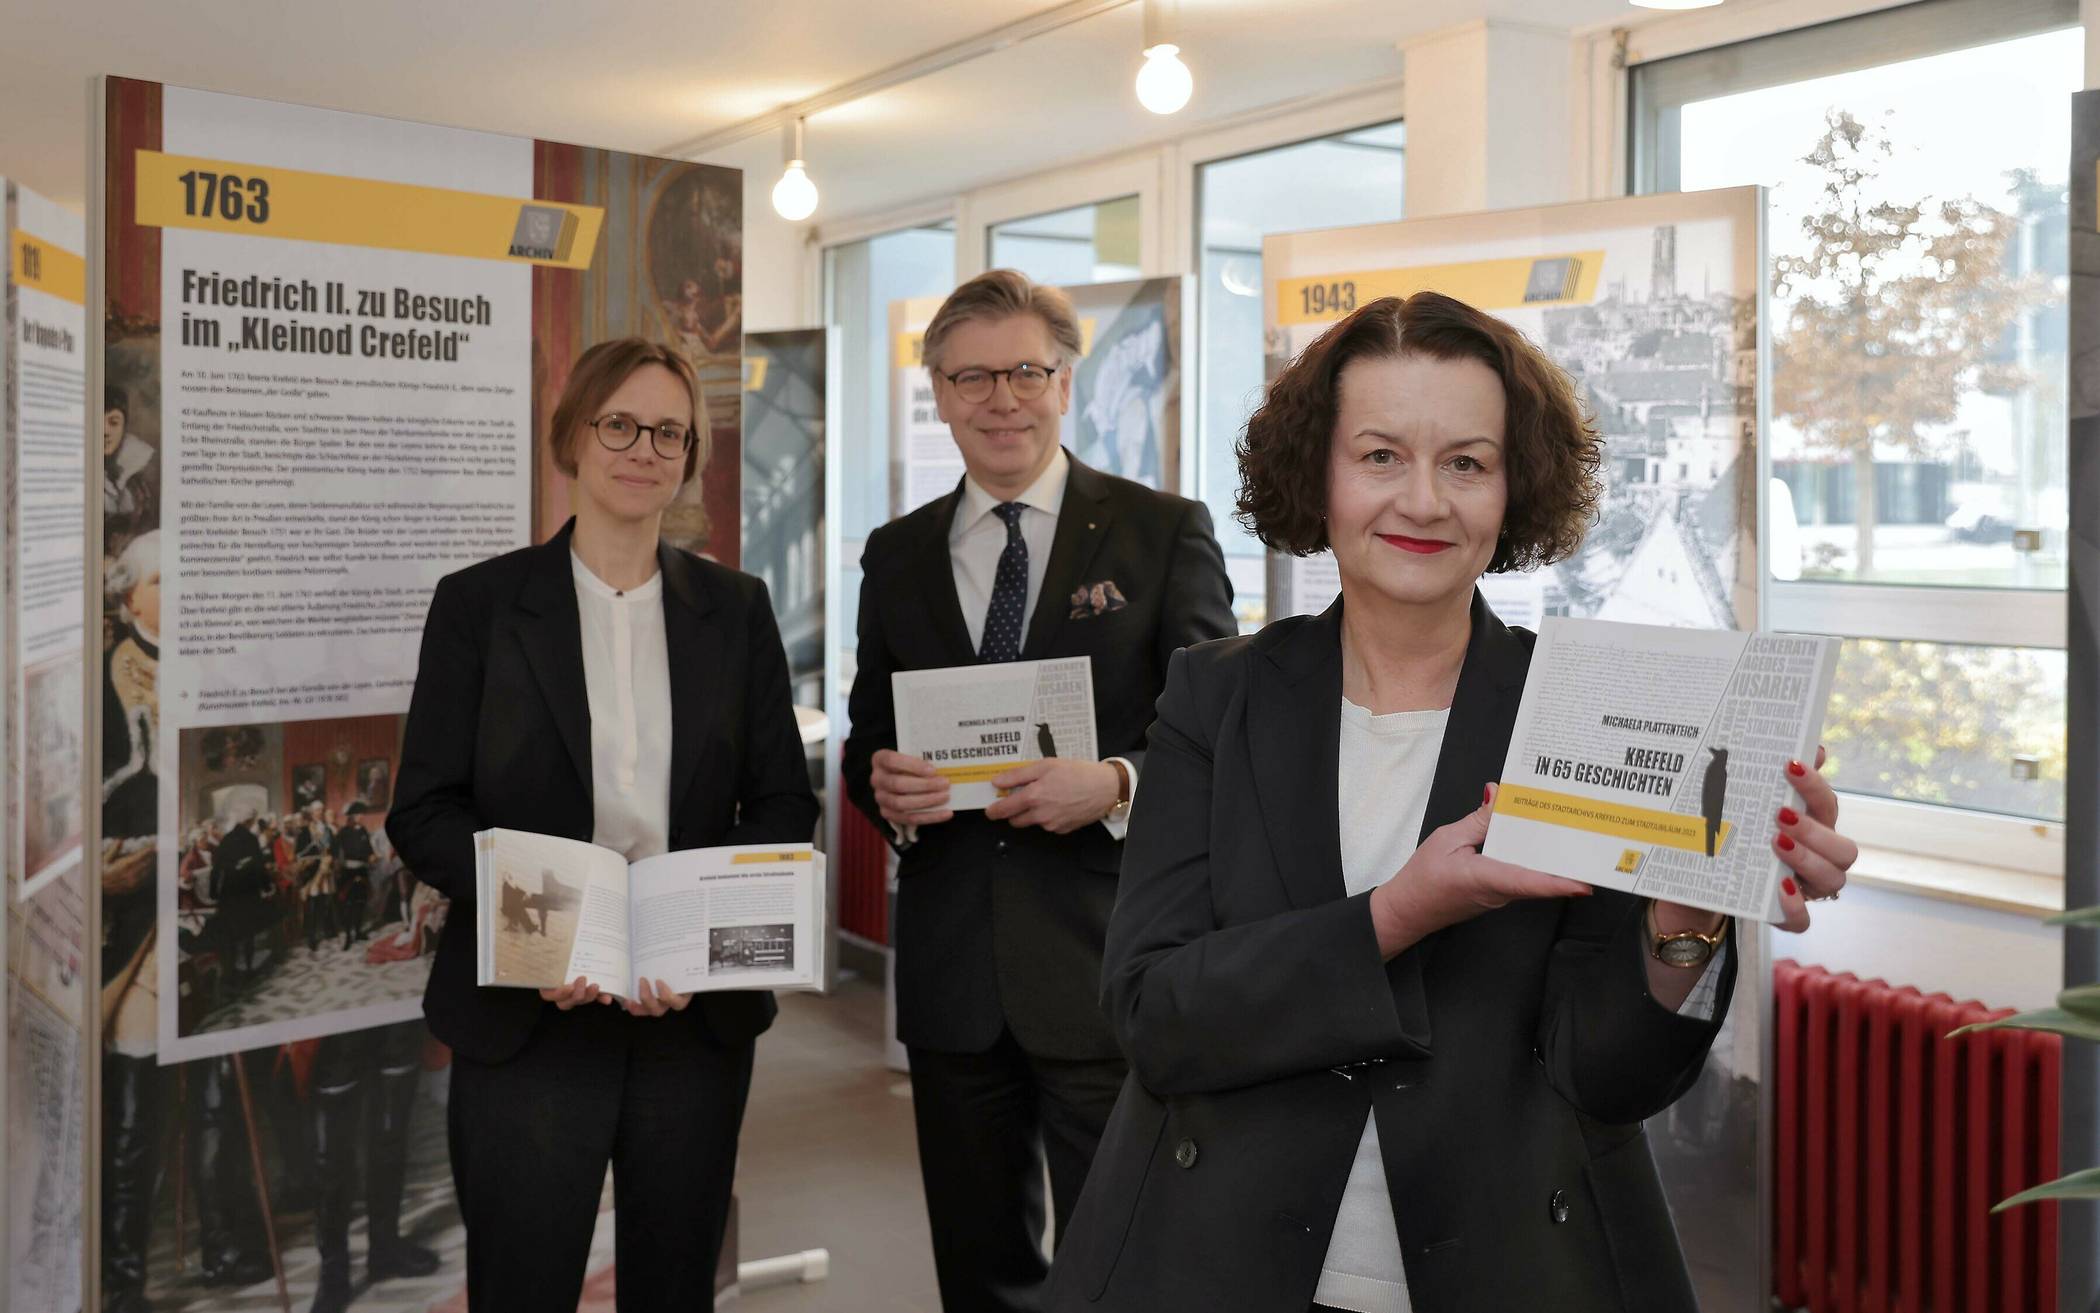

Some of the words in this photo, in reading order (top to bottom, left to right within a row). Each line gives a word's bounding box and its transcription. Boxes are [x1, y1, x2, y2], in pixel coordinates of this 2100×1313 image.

[179, 171, 270, 224] 1763
[508, 243, 555, 261] ARCHIV
[181, 269, 317, 312] Friedrich
[326, 283, 351, 315] II.
[357, 291, 386, 318] zu
[394, 289, 492, 326] Besuch
[1300, 282, 1356, 315] 1943
[181, 310, 220, 350] im
[227, 313, 352, 356] „Kleinod
[360, 323, 470, 362] Crefeld“
[980, 731, 1021, 745] KREFELD
[1601, 715, 1642, 731] MICHAELA
[1643, 720, 1699, 739] PLATTENTEICH
[922, 750, 933, 761] IN
[935, 749, 949, 761] 65
[951, 743, 1019, 760] GESCHICHTEN
[1624, 747, 1684, 773] KREFELD
[1535, 756, 1551, 776] IN
[1552, 761, 1572, 780] 65
[1574, 763, 1673, 797] GESCHICHTEN
[1539, 801, 1551, 810] DES
[1552, 803, 1594, 820] STADTARCHIVS
[1595, 811, 1620, 824] KREFELD
[1621, 816, 1635, 826] ZUM
